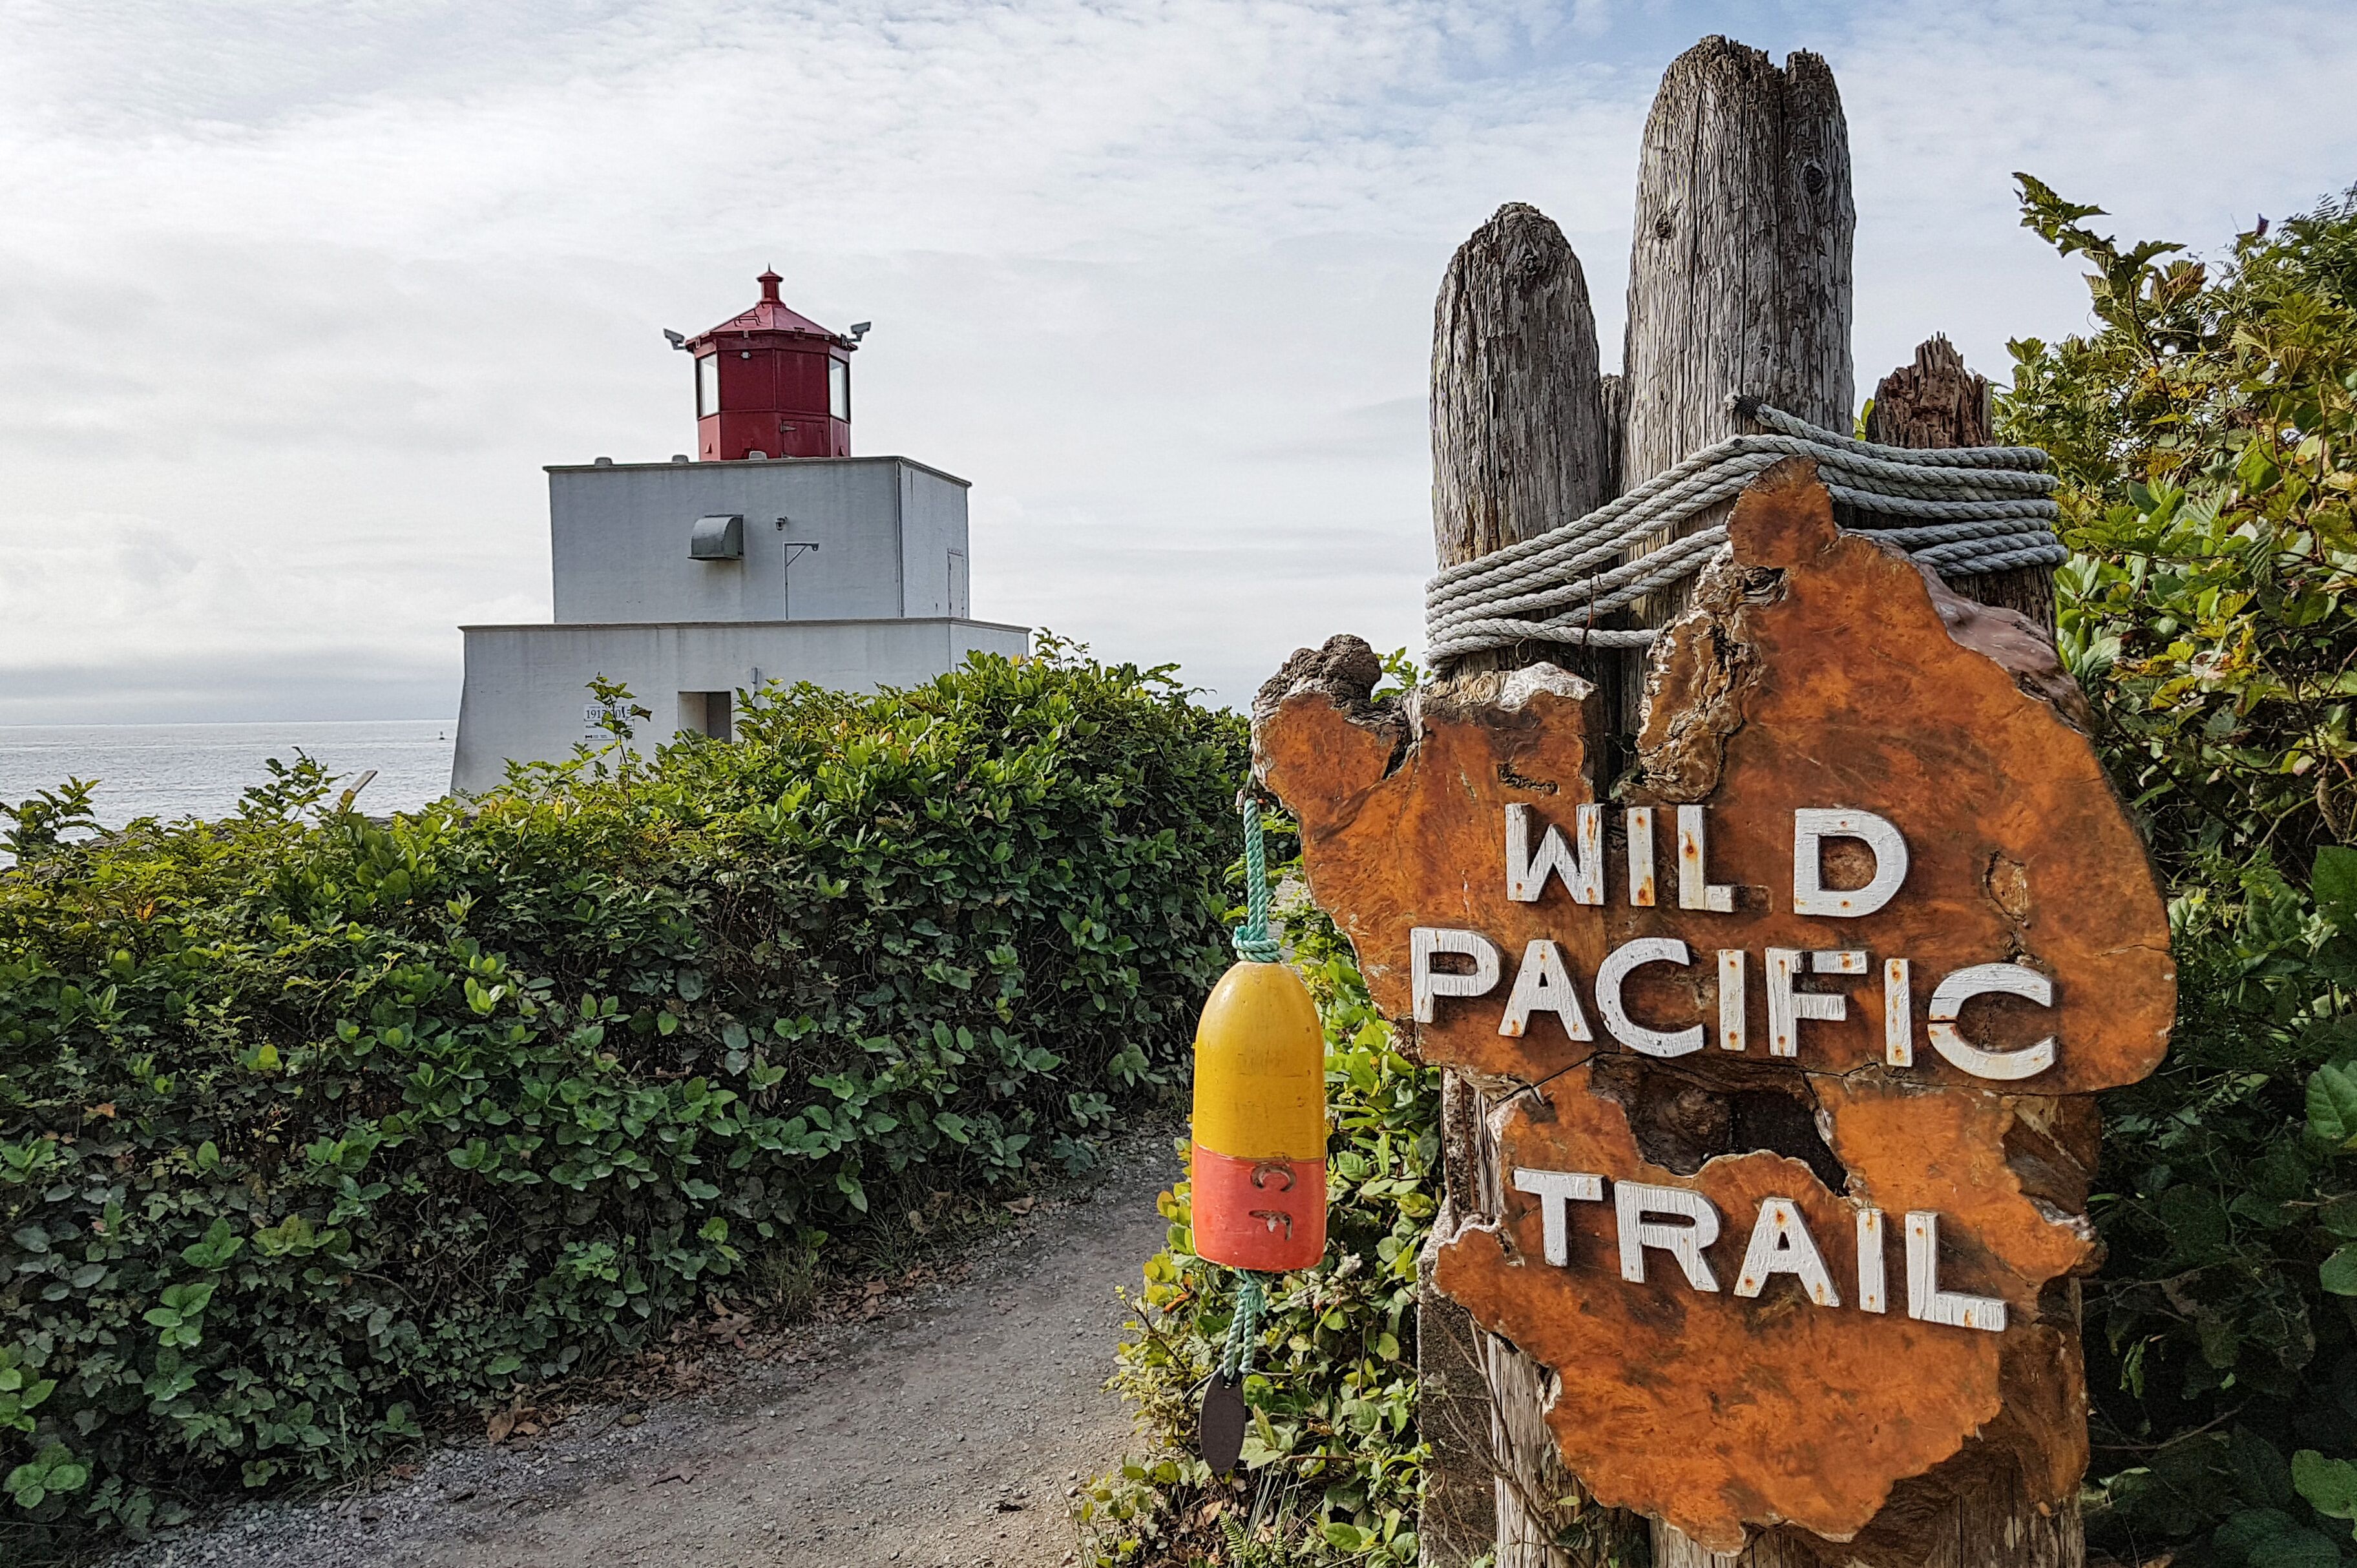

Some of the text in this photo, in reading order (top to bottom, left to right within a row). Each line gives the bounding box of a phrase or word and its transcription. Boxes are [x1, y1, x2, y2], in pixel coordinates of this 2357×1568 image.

[1505, 803, 1910, 917] WILD
[1410, 926, 2057, 1081] PACIFIC
[1513, 1167, 2008, 1333] TRAIL
